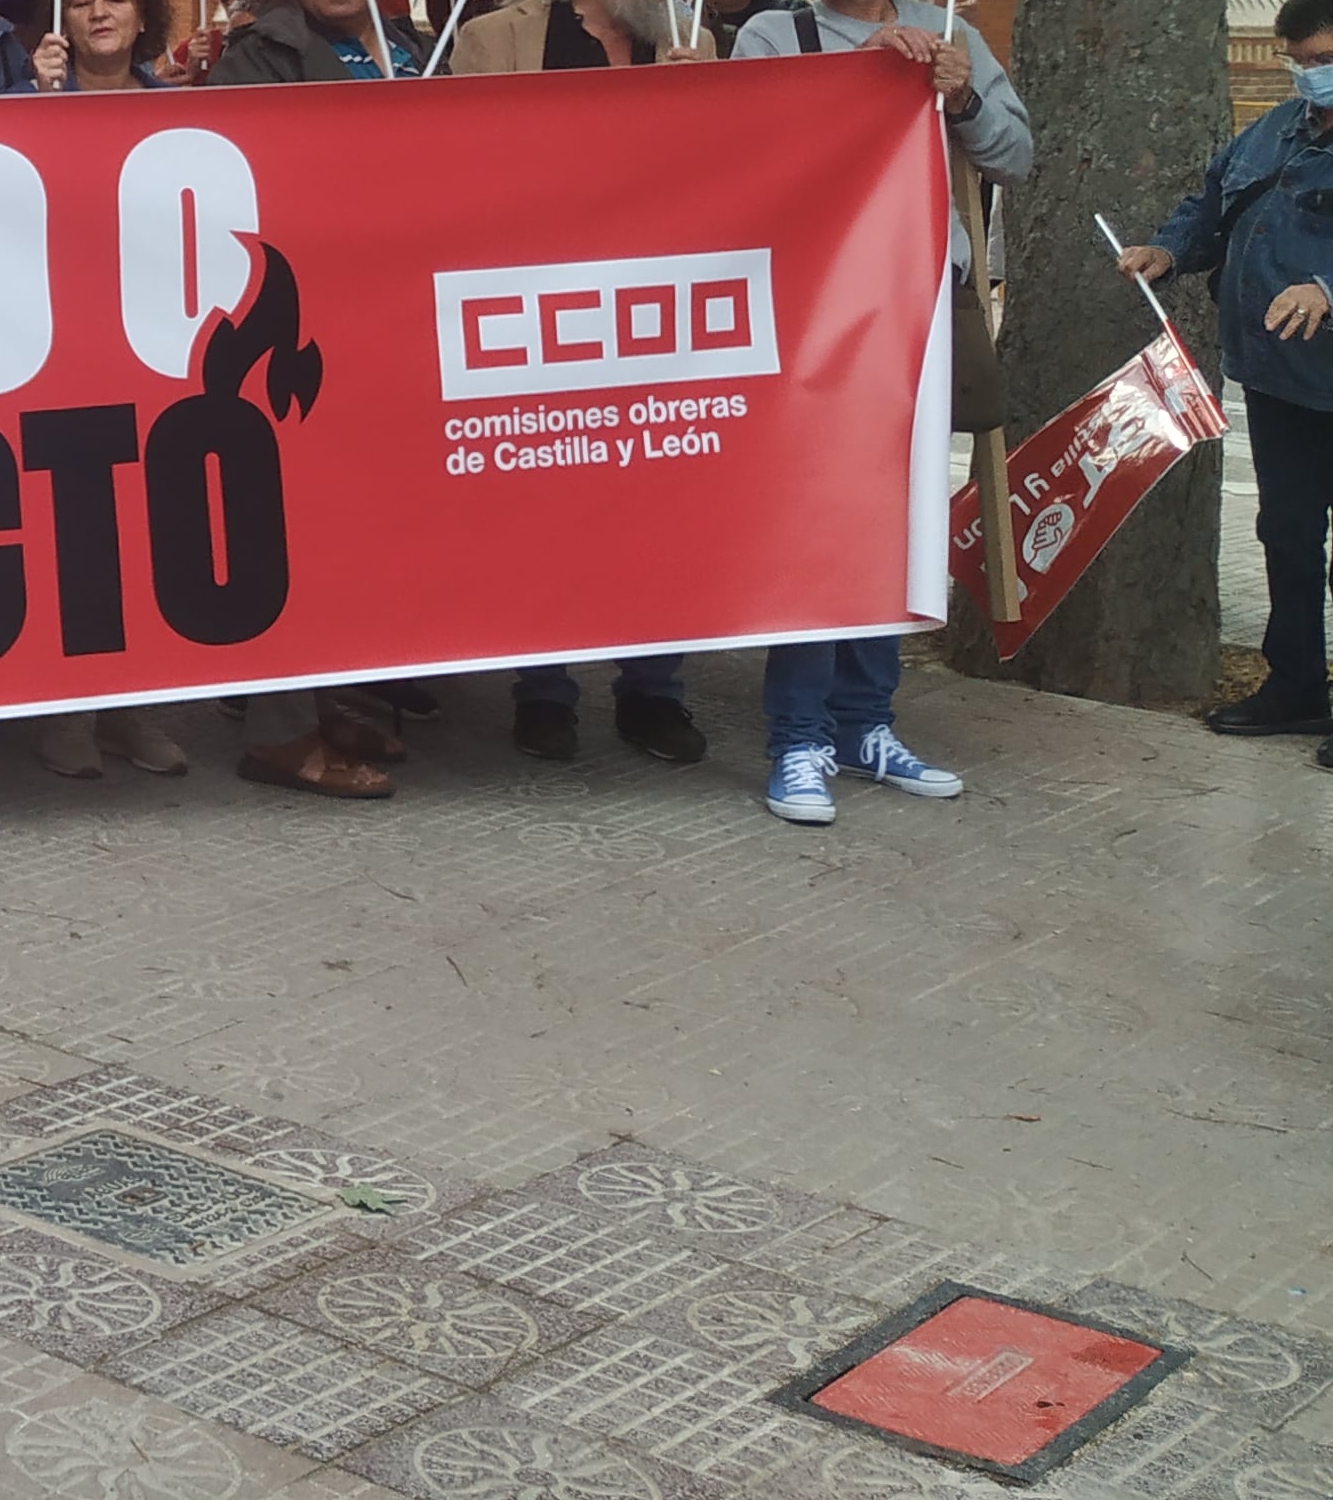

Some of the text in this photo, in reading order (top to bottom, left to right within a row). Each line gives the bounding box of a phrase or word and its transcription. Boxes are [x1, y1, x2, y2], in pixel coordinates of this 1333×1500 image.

[118, 128, 260, 380] O
[460, 276, 754, 372] CCOO
[444, 393, 748, 442] comisiones obreras
[446, 427, 721, 477] de Castilla y León
